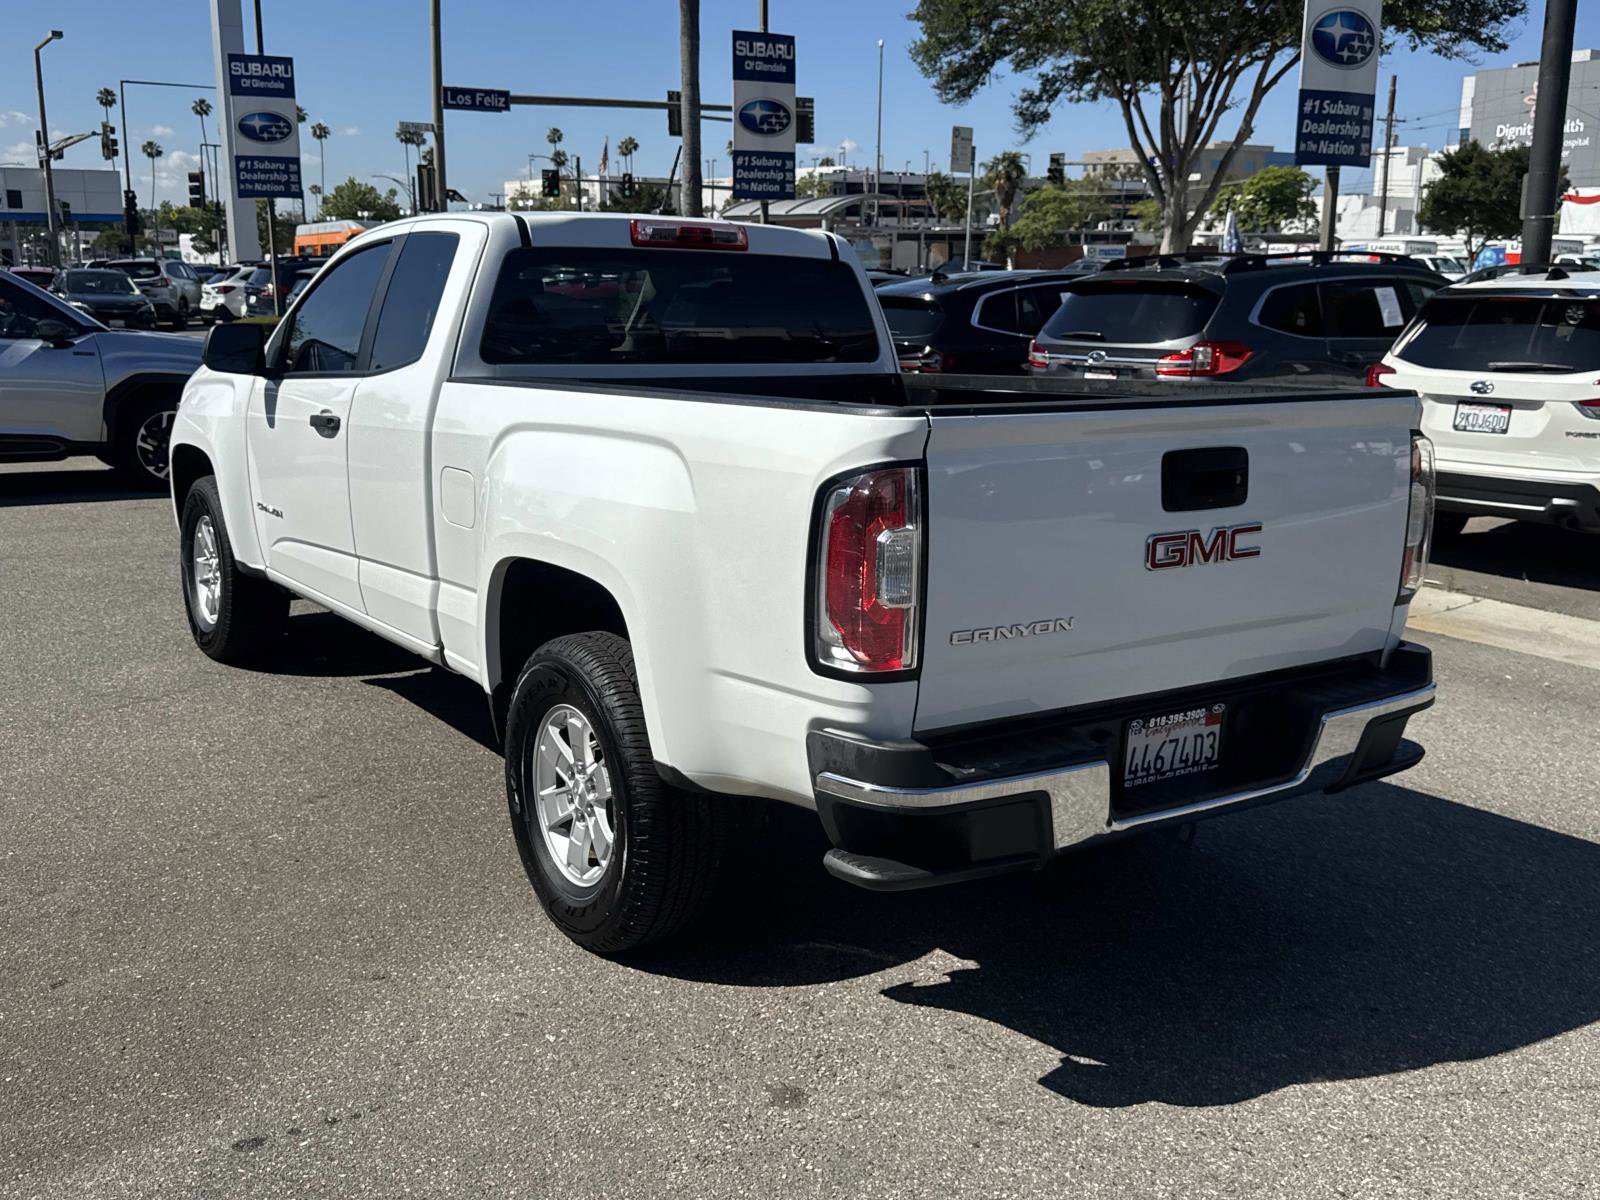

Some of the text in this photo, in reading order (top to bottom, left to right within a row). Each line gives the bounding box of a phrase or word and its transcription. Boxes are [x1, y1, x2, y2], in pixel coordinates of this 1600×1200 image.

[735, 40, 794, 60] SUBARU
[230, 61, 292, 78] SUBARU
[755, 60, 787, 73] Glendale
[447, 91, 506, 108] Los Feliz
[1303, 99, 1360, 117] #1 Subaru
[1302, 119, 1361, 140] Dealership
[1496, 122, 1534, 140] Dignit
[1318, 139, 1355, 156] Nation
[239, 160, 286, 171] #1 Subaru
[736, 155, 782, 167] #1 Subaru
[239, 171, 289, 183] Dealership
[736, 168, 785, 182] Dealership
[254, 182, 285, 192] Nation
[749, 181, 780, 192] Nation
[1144, 521, 1263, 571] GMC
[949, 616, 1075, 646] CANYON
[1149, 708, 1206, 728] 818-396-3900
[1127, 731, 1218, 778] 44674D3
